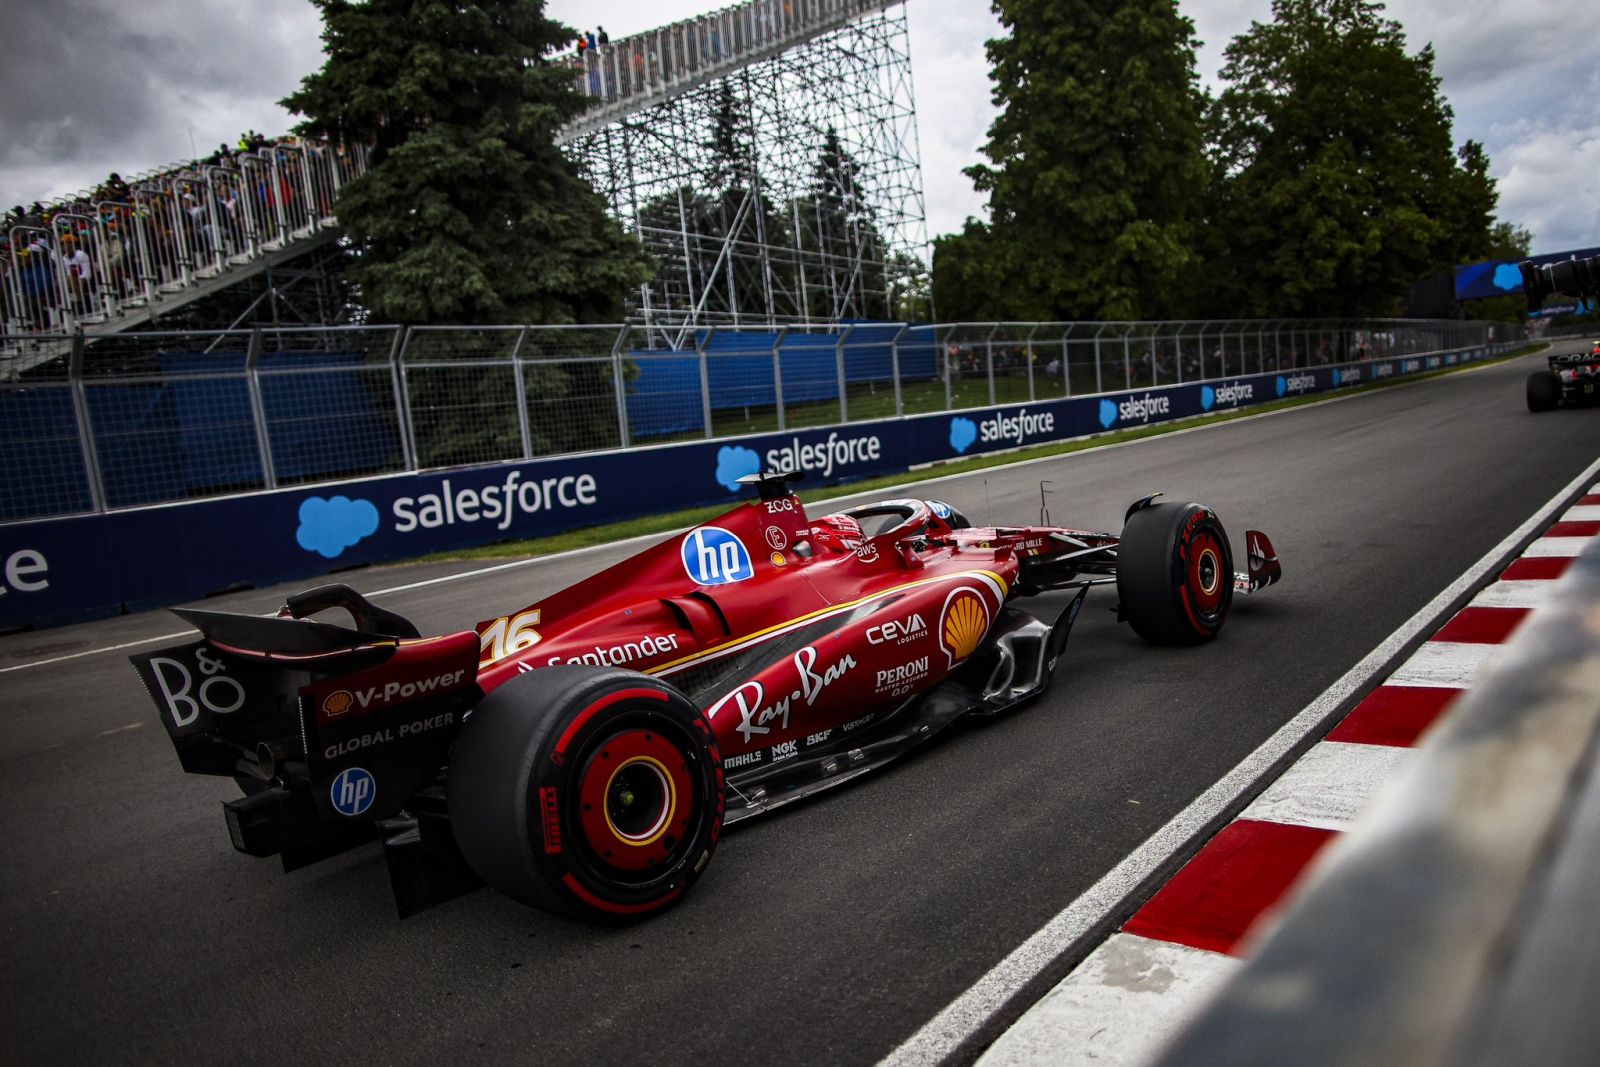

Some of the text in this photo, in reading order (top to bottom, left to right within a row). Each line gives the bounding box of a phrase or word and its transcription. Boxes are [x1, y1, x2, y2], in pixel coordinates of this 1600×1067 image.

[1119, 393, 1170, 425] salesforce
[1215, 381, 1253, 411] salesforce
[979, 411, 1054, 446] salesforce
[766, 431, 881, 478] salesforce
[393, 471, 597, 531] salesforce
[763, 498, 793, 514] ZCG
[695, 528, 742, 584] hp
[856, 542, 877, 558] aws
[478, 609, 542, 670] 16
[897, 630, 928, 646] LOGISTICS
[876, 655, 929, 688] PERONI
[355, 668, 465, 709] V-Power
[324, 712, 455, 760] GLOBAL POKER
[771, 739, 798, 755] NGK
[806, 728, 833, 747] SKF
[724, 750, 762, 769] MAHLE
[338, 772, 370, 815] hp
